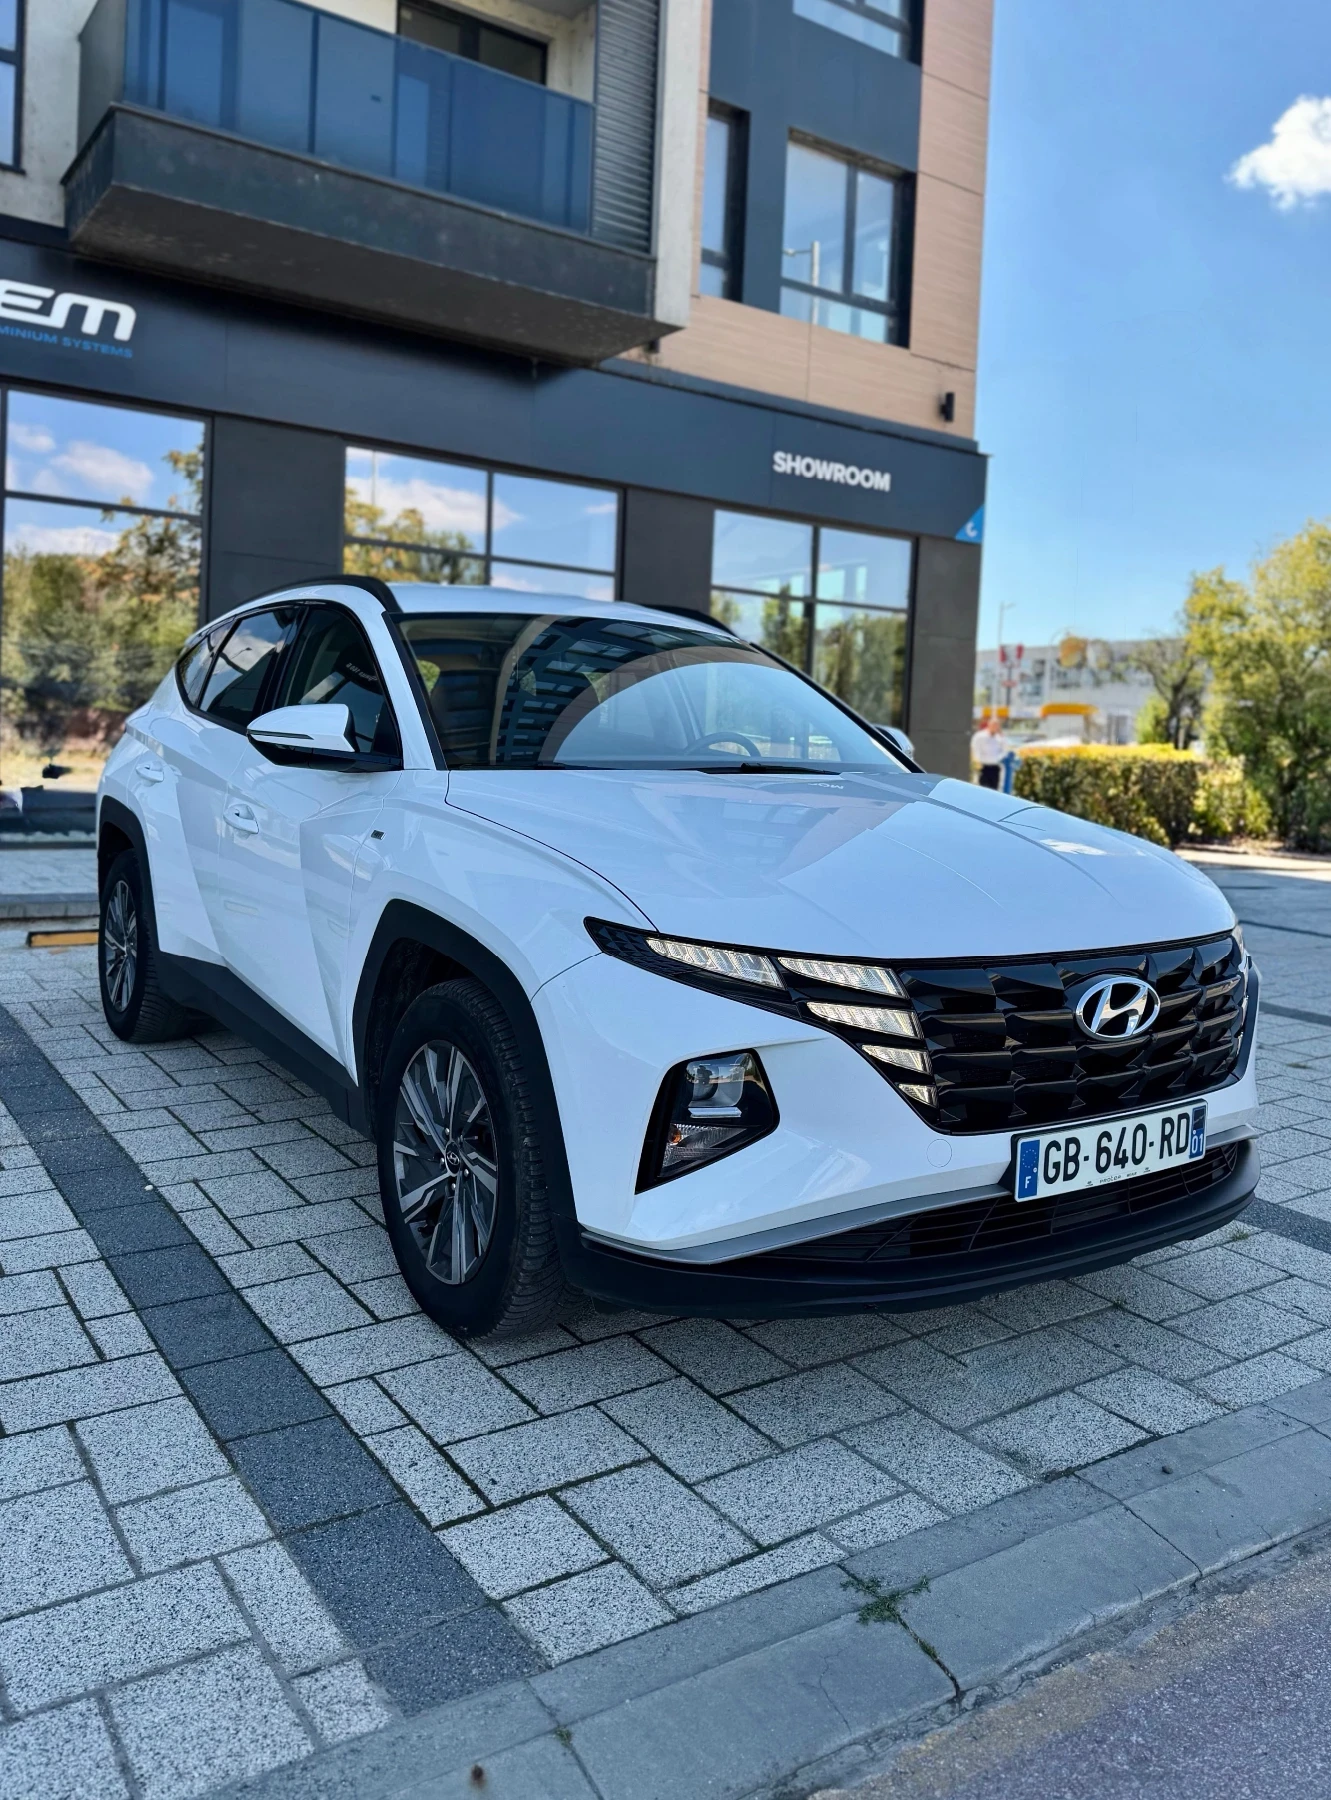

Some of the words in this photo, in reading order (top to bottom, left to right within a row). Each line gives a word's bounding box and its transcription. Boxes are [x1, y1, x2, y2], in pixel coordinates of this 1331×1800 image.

[62, 336, 133, 359] SYSTEMS
[772, 450, 892, 492] SHOWROOM
[1191, 1133, 1204, 1154] 01
[1024, 1175, 1032, 1189] F
